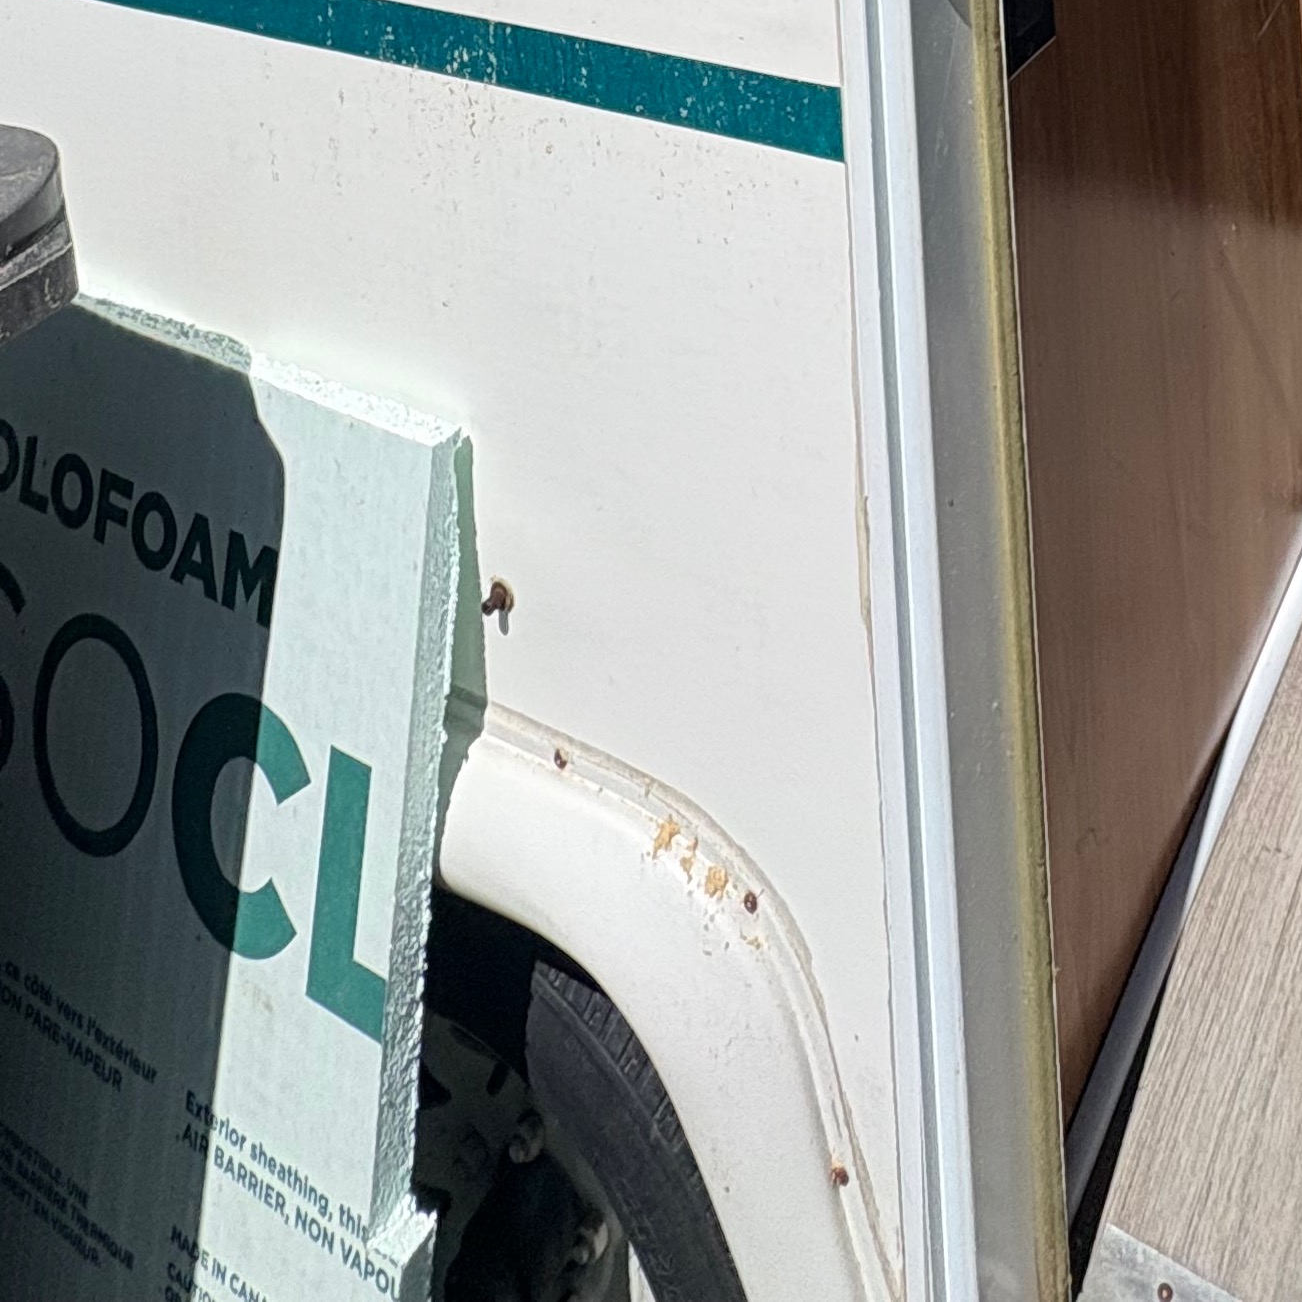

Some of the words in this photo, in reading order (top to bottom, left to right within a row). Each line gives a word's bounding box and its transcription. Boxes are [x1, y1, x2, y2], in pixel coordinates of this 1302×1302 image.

[182, 1123, 209, 1158] AIR
[213, 1144, 290, 1225] BARRIER,
[295, 1204, 336, 1256] NON
[185, 1089, 247, 1153] Exterior
[250, 1142, 334, 1223] sheathing,
[211, 1257, 227, 1285] IN
